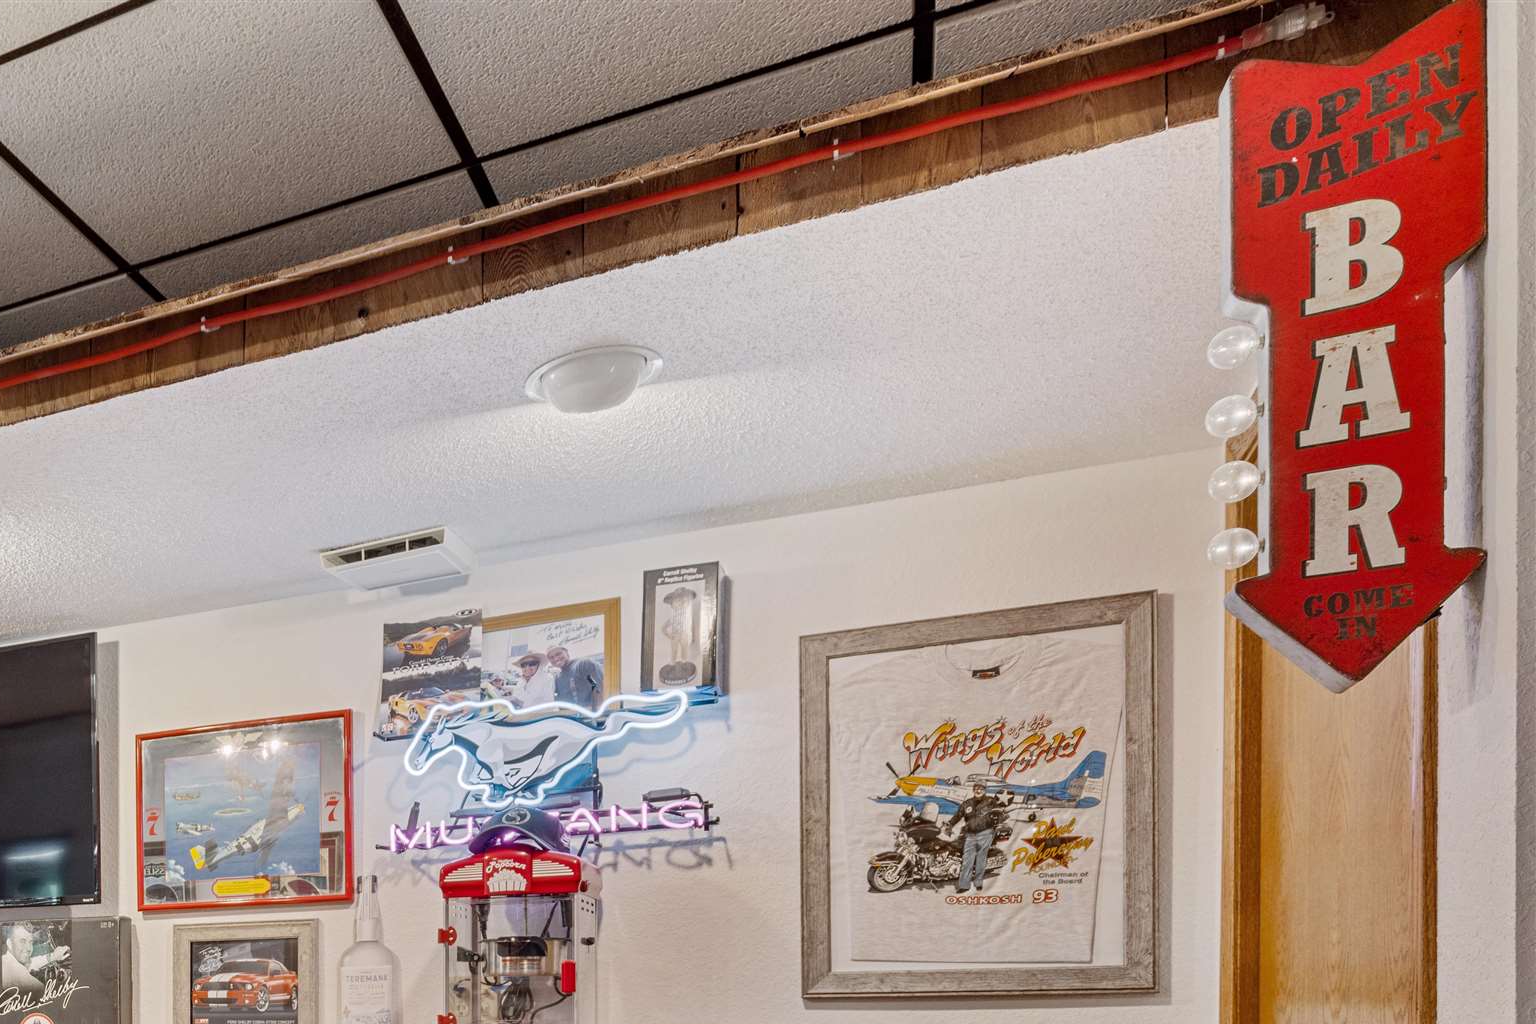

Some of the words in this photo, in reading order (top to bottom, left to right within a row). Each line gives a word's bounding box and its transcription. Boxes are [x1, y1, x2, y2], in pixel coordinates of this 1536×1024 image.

[1269, 42, 1464, 153] OPEN
[1256, 90, 1477, 208] DAILY
[1295, 198, 1411, 579] BAR
[1303, 583, 1414, 618] COME
[1335, 615, 1377, 640] IN
[902, 719, 1007, 771] Wings
[1027, 711, 1053, 732] the
[985, 726, 1087, 780] World
[389, 799, 705, 852] MUANG
[485, 860, 527, 874] Popcorn
[944, 893, 1023, 906] OSHKOSH
[1032, 888, 1059, 905] 93
